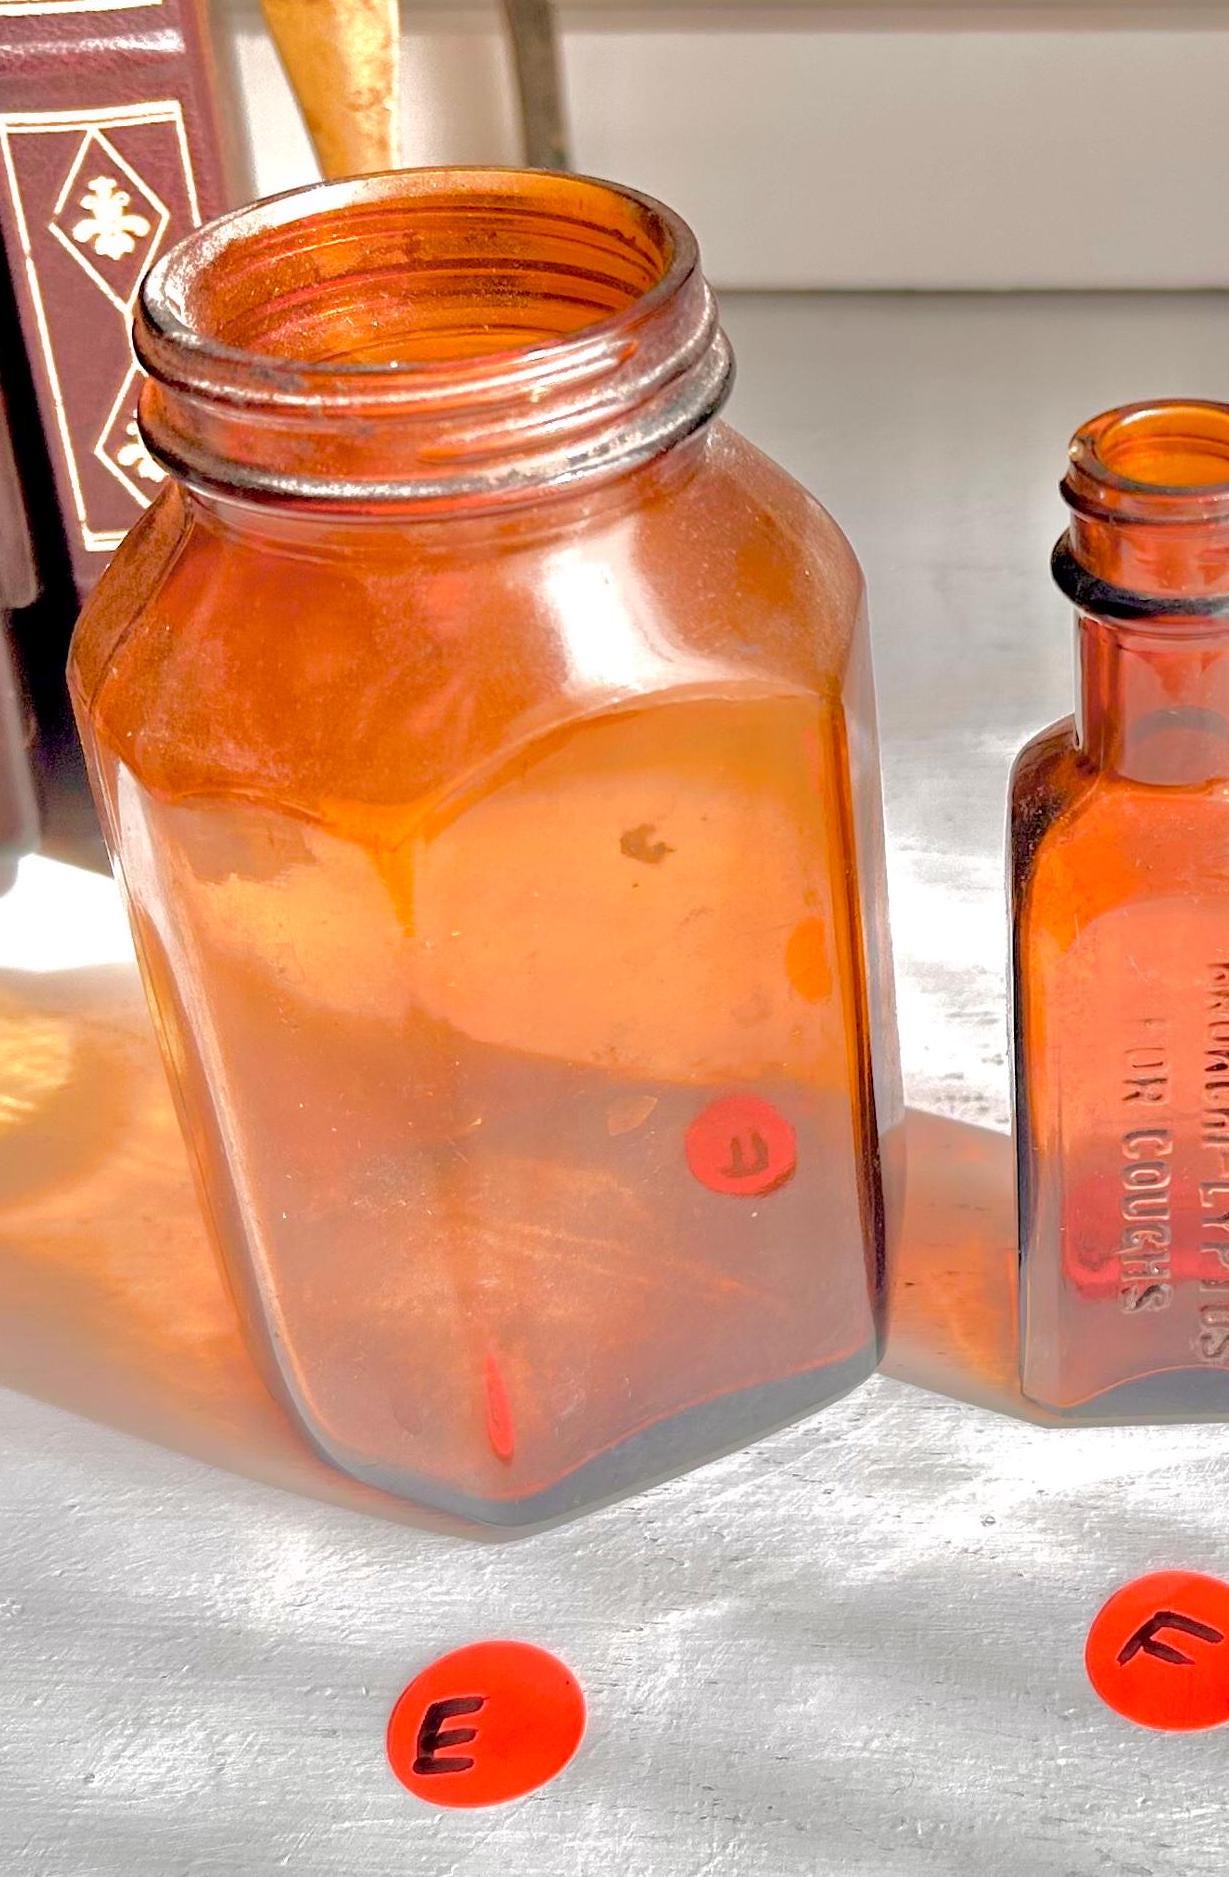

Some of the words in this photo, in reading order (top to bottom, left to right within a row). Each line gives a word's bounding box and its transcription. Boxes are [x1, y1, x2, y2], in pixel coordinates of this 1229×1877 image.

[1119, 1128, 1173, 1314] COUGHS
[1118, 1611, 1224, 1666] F
[412, 1696, 486, 1775] E
